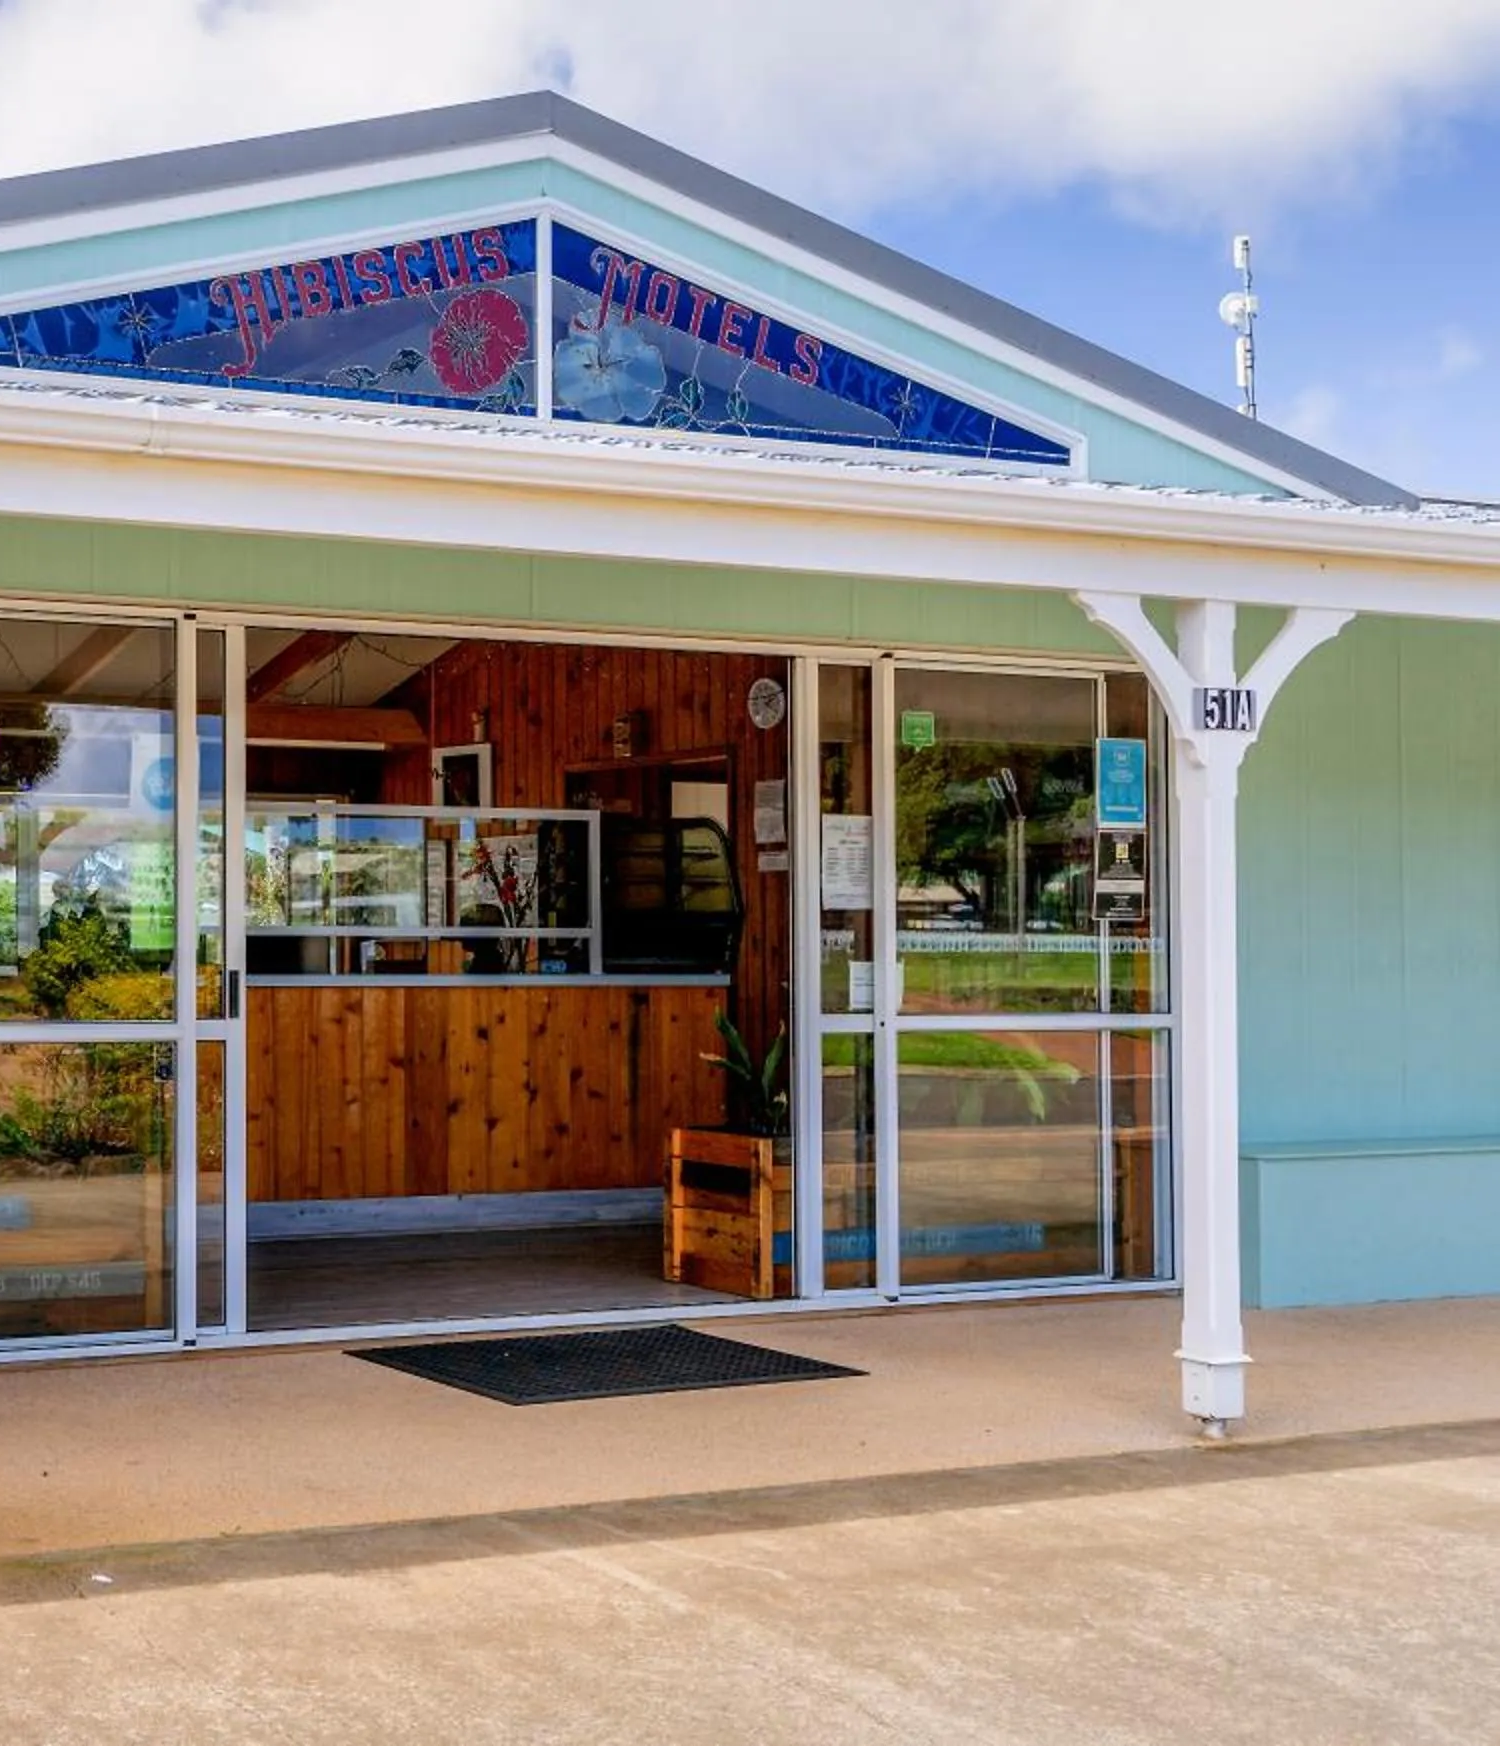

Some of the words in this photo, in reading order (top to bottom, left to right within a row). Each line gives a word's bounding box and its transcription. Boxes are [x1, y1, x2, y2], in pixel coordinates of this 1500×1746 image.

[210, 227, 510, 377] HIBISCUS
[569, 246, 824, 386] MOTELS
[1205, 689, 1251, 731] 51A
